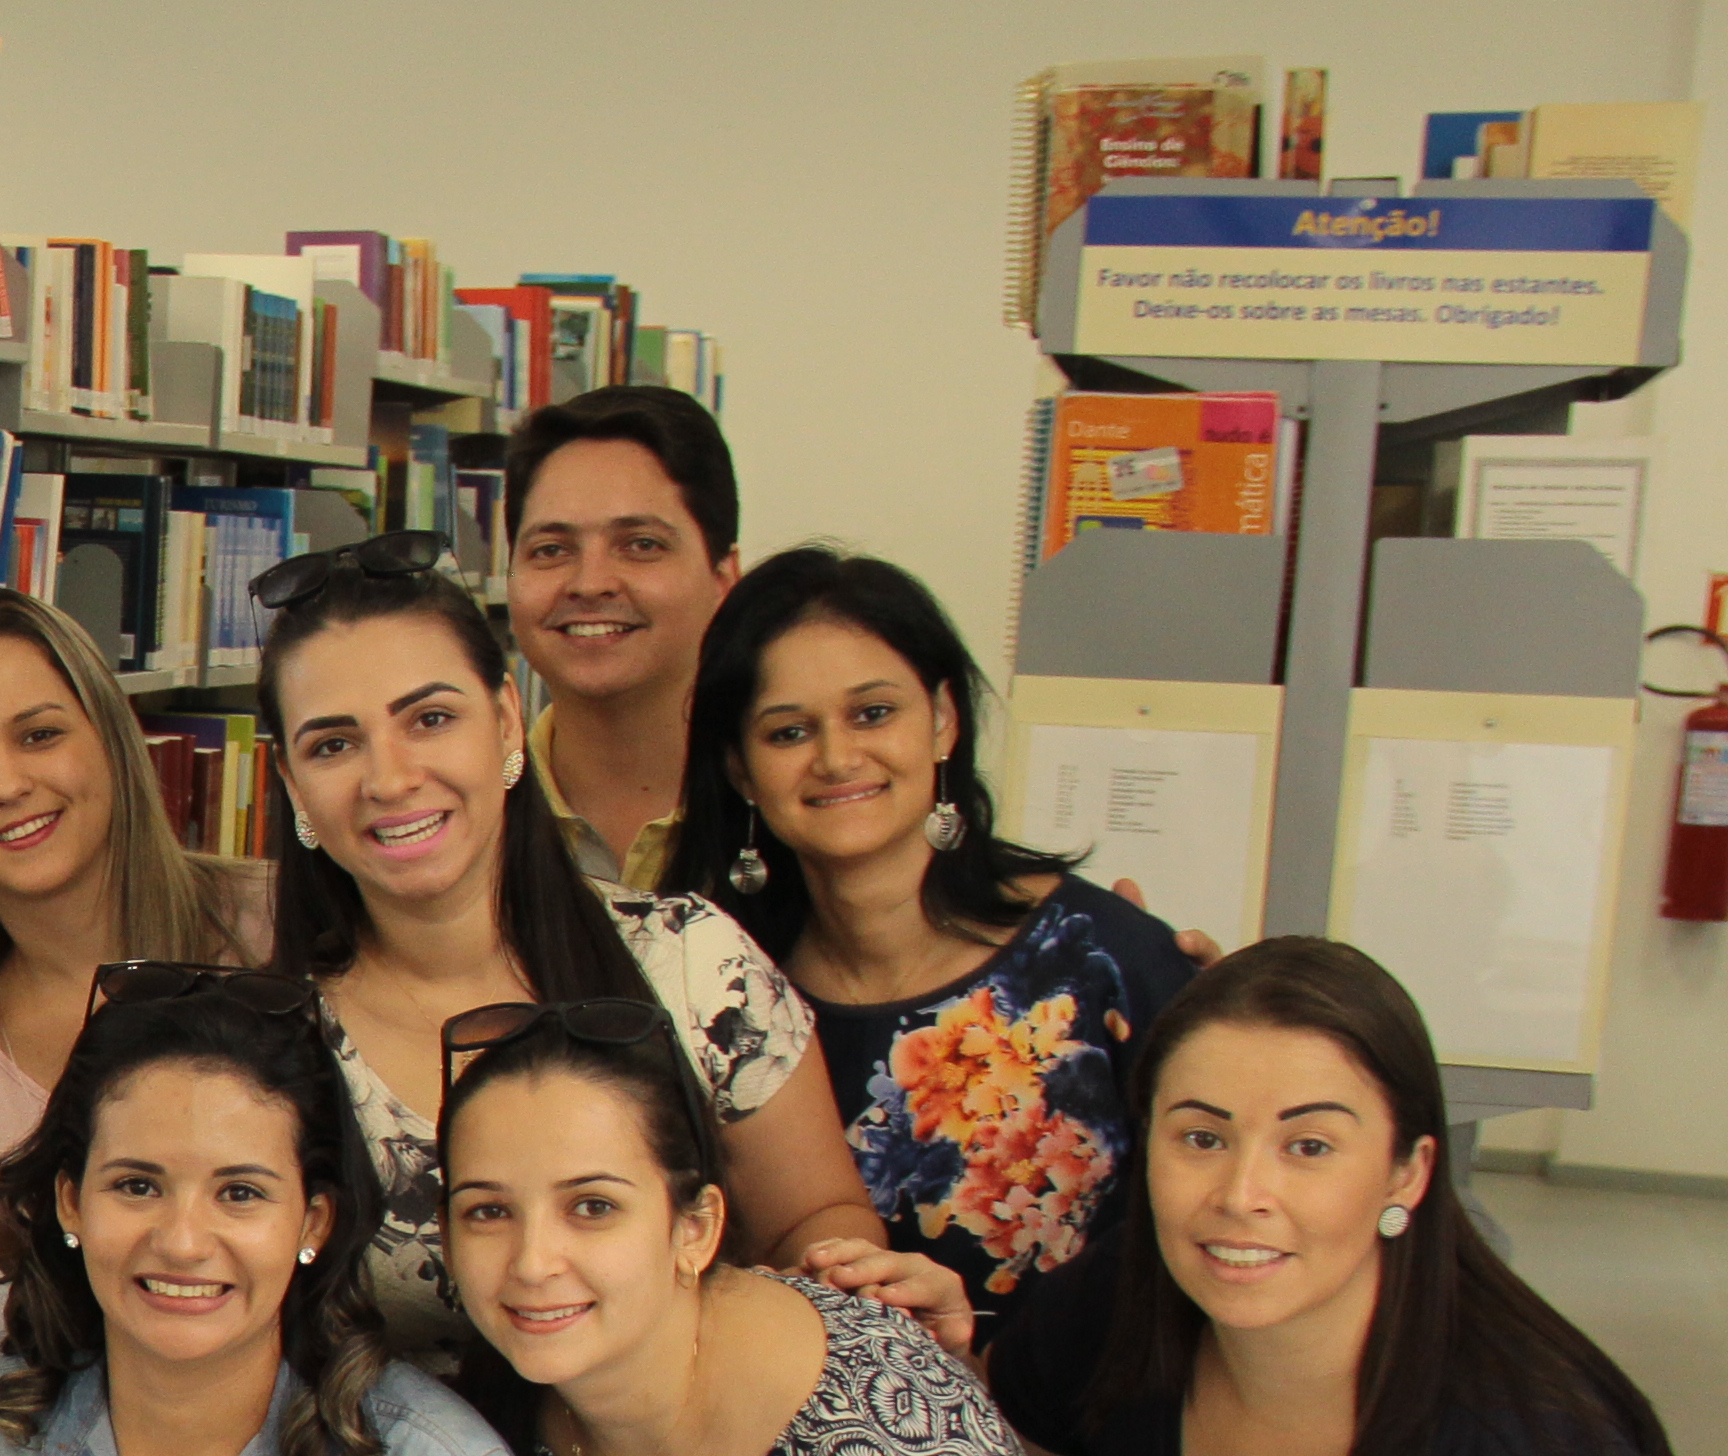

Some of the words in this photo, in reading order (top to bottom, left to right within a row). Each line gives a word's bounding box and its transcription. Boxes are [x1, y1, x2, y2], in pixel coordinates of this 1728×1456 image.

[1291, 209, 1442, 242] Atenção!
[1096, 267, 1163, 290] Favor
[1168, 268, 1212, 290] não
[1218, 269, 1331, 291] recolocar
[1334, 275, 1364, 291] os
[1367, 270, 1435, 292] livros
[1441, 276, 1484, 293] nas
[1492, 275, 1605, 296] estantes.
[1132, 300, 1234, 320] Deixe-os
[1240, 301, 1307, 321] sobre
[1312, 306, 1339, 321] as
[1346, 305, 1425, 323] mesas.
[1435, 304, 1562, 329] Obrigado!
[1067, 420, 1132, 440] Dante
